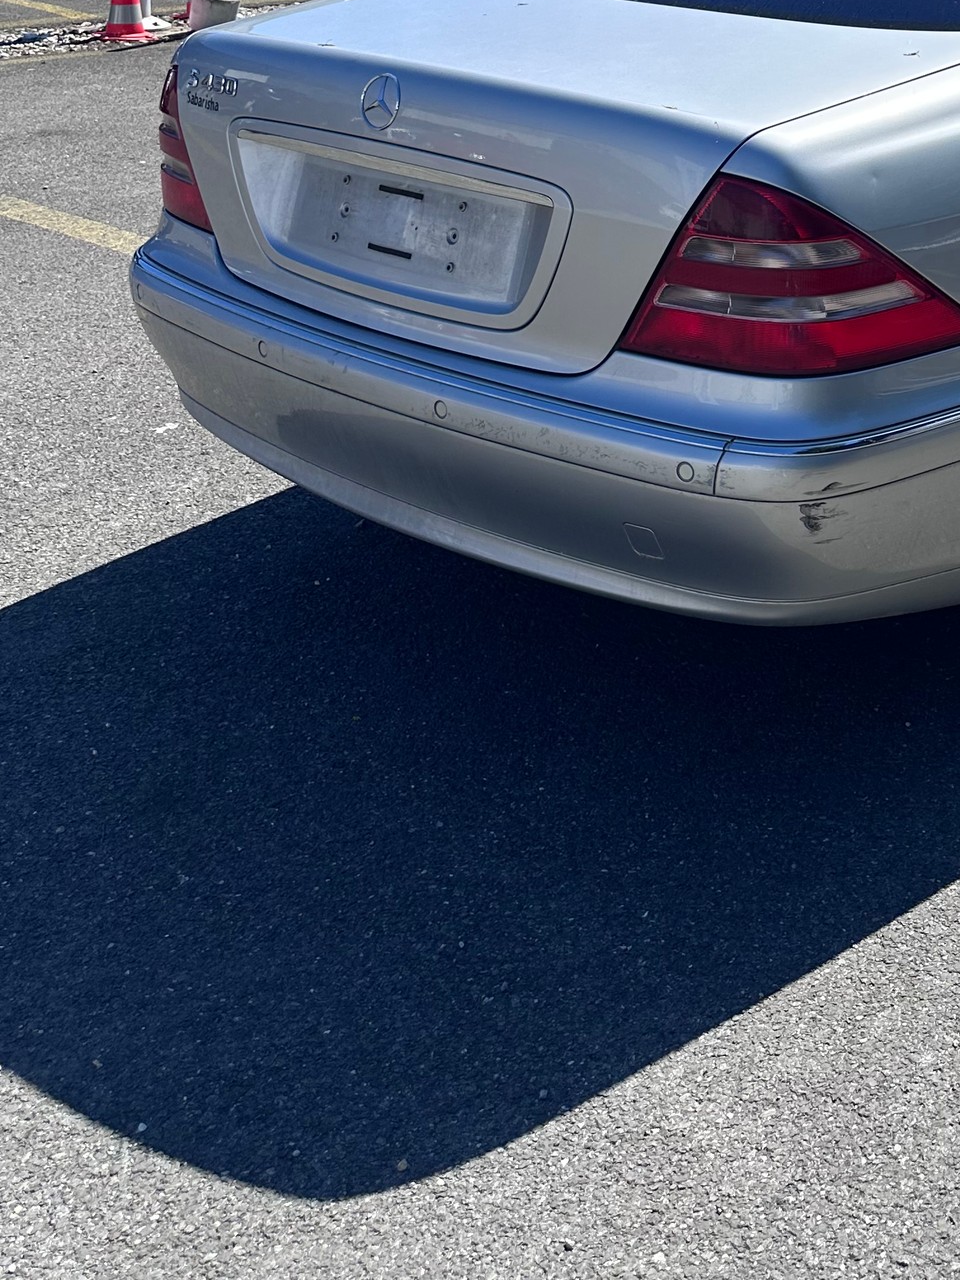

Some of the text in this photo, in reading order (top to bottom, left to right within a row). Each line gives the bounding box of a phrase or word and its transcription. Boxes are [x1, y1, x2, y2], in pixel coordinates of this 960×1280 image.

[187, 68, 238, 97] S 430
[187, 90, 220, 112] Sabarisha
